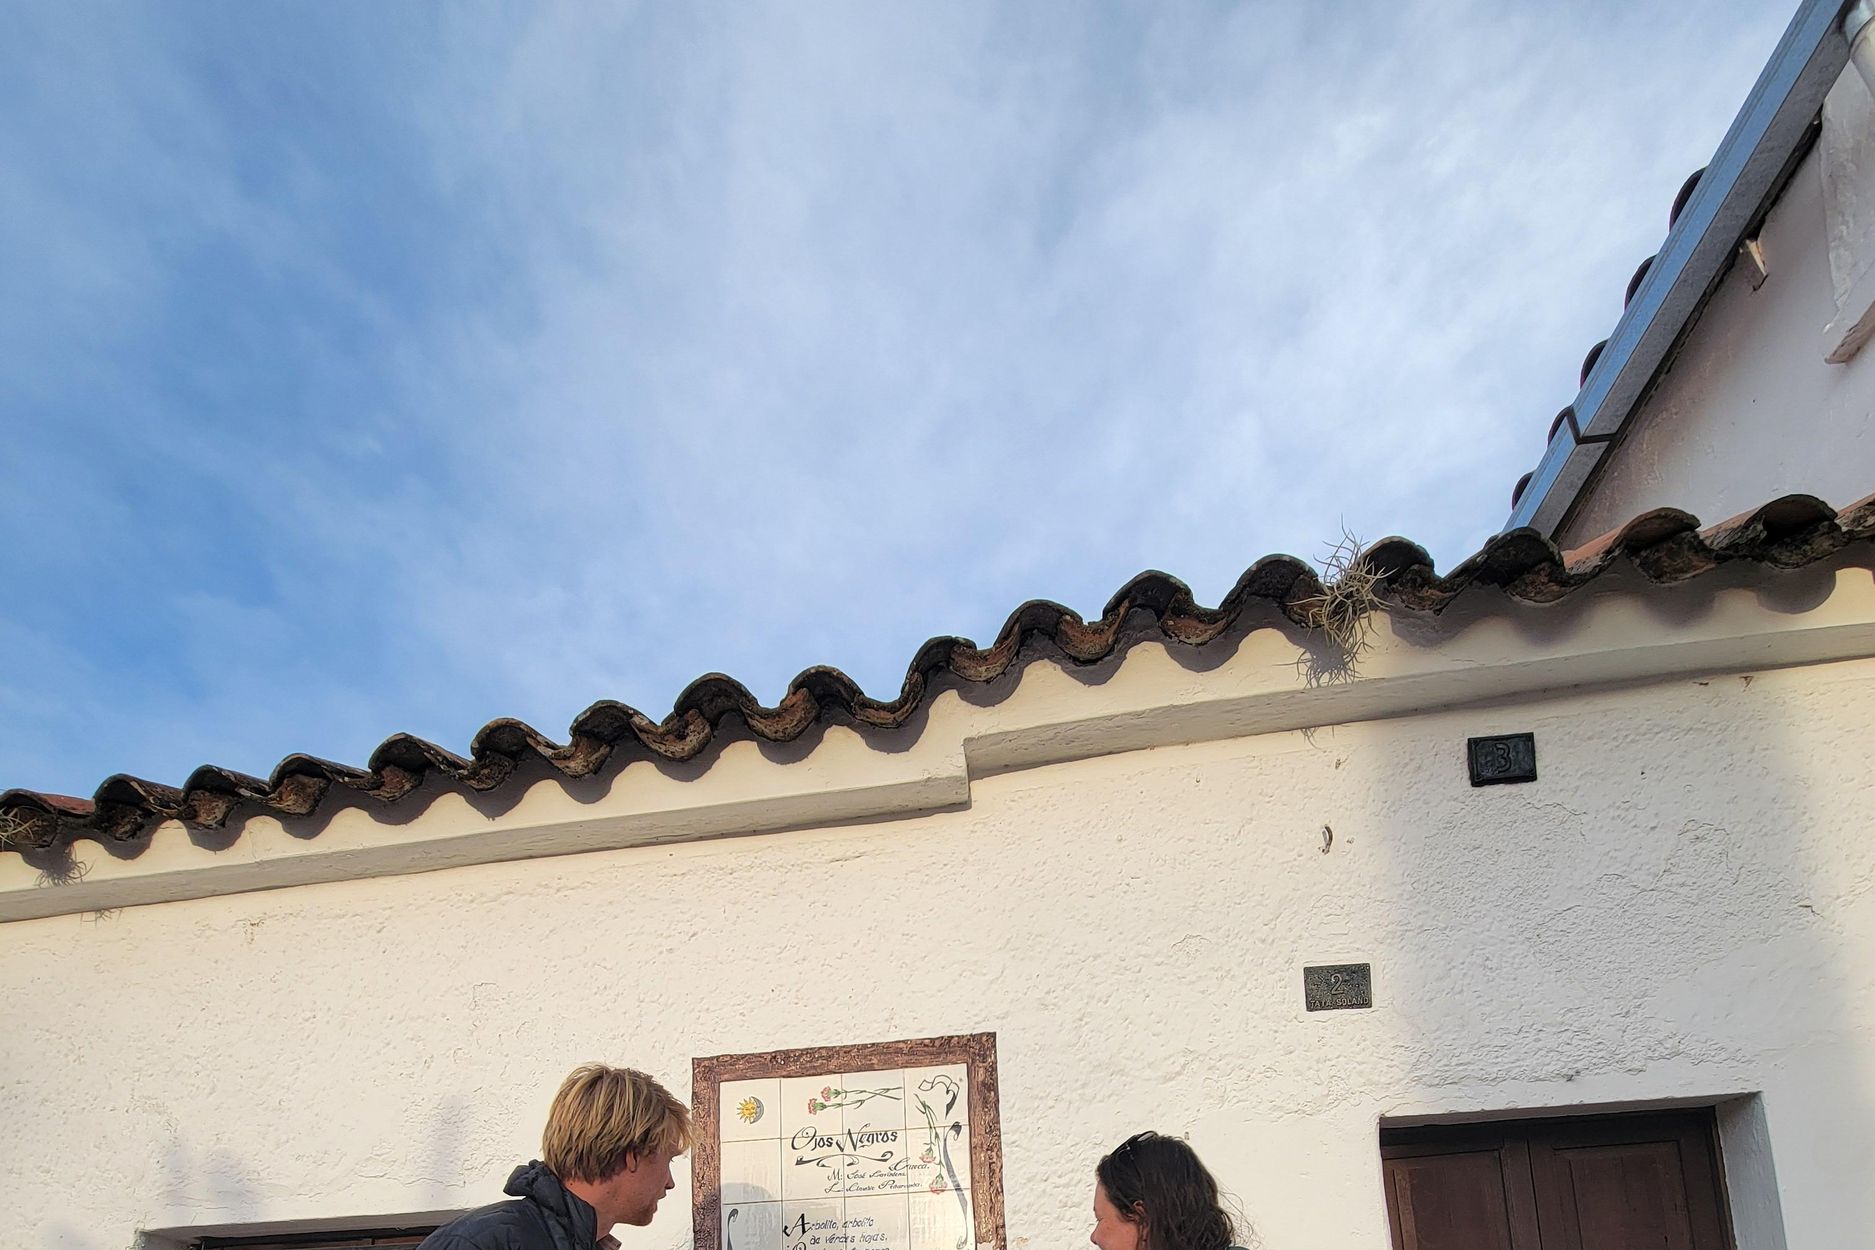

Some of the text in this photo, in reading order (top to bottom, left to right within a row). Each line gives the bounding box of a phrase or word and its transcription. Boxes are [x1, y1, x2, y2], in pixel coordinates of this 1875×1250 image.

[1495, 742, 1512, 774] 3
[1331, 973, 1345, 995] 2
[791, 1123, 898, 1152] Ojos Negros
[842, 1215, 874, 1228] arbolito
[810, 1235, 820, 1245] de
[825, 1234, 855, 1244] verdes
